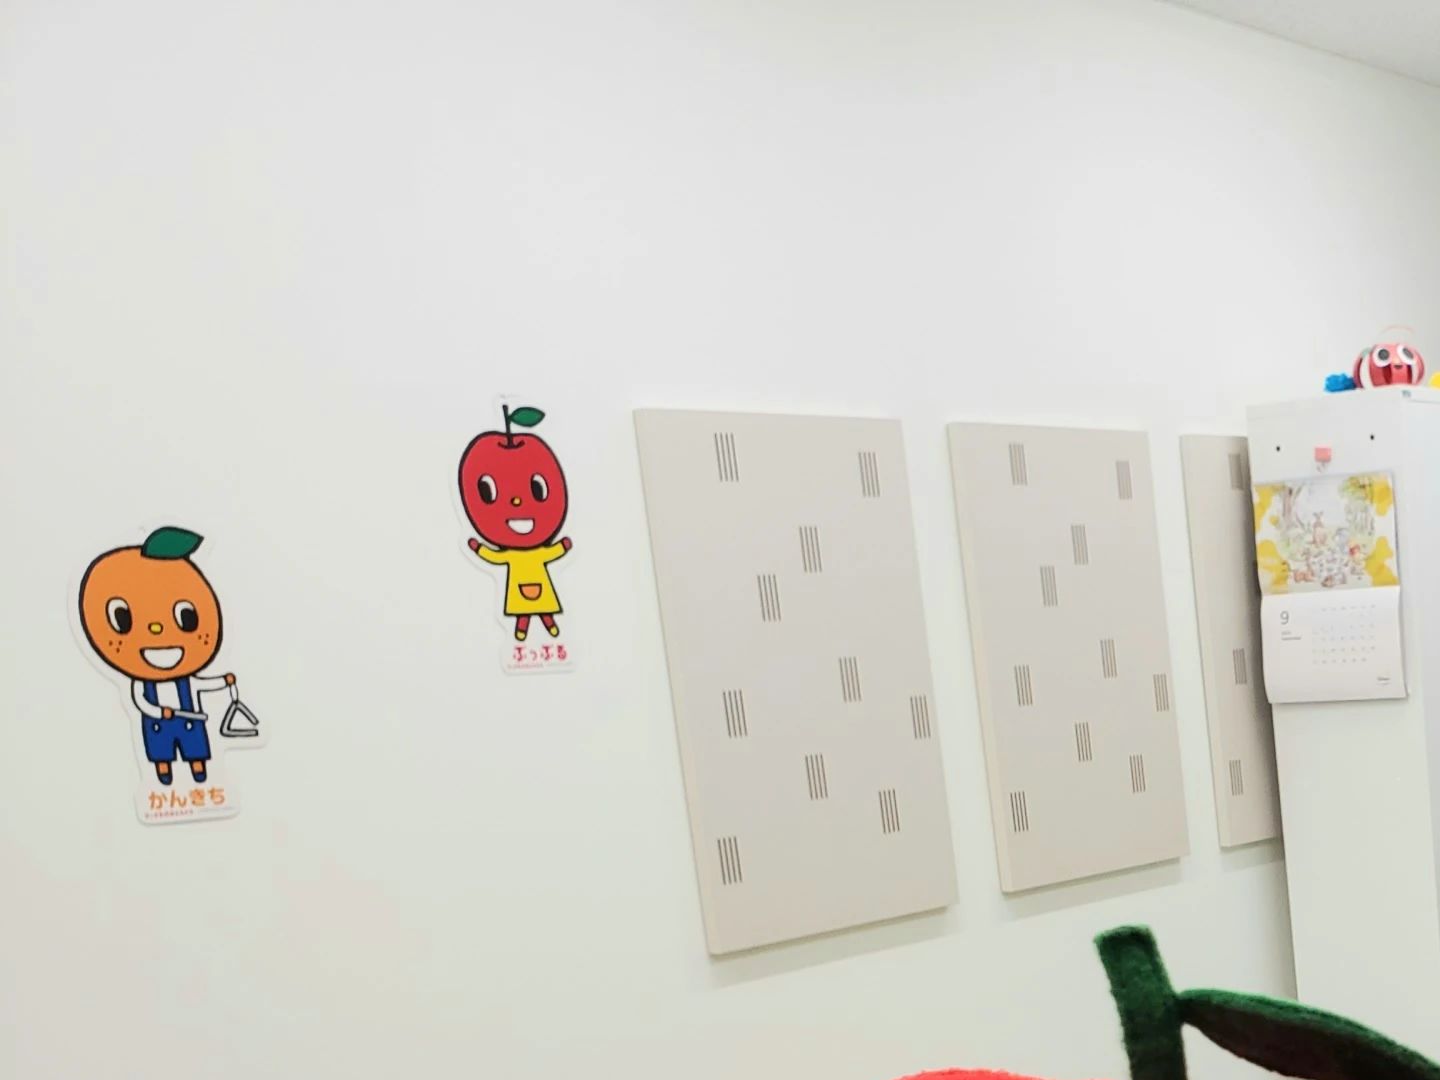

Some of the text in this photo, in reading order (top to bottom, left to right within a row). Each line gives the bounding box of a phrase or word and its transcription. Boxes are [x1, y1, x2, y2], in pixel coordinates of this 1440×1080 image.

[1280, 610, 1289, 625] 9
[148, 787, 226, 810] かんきち
